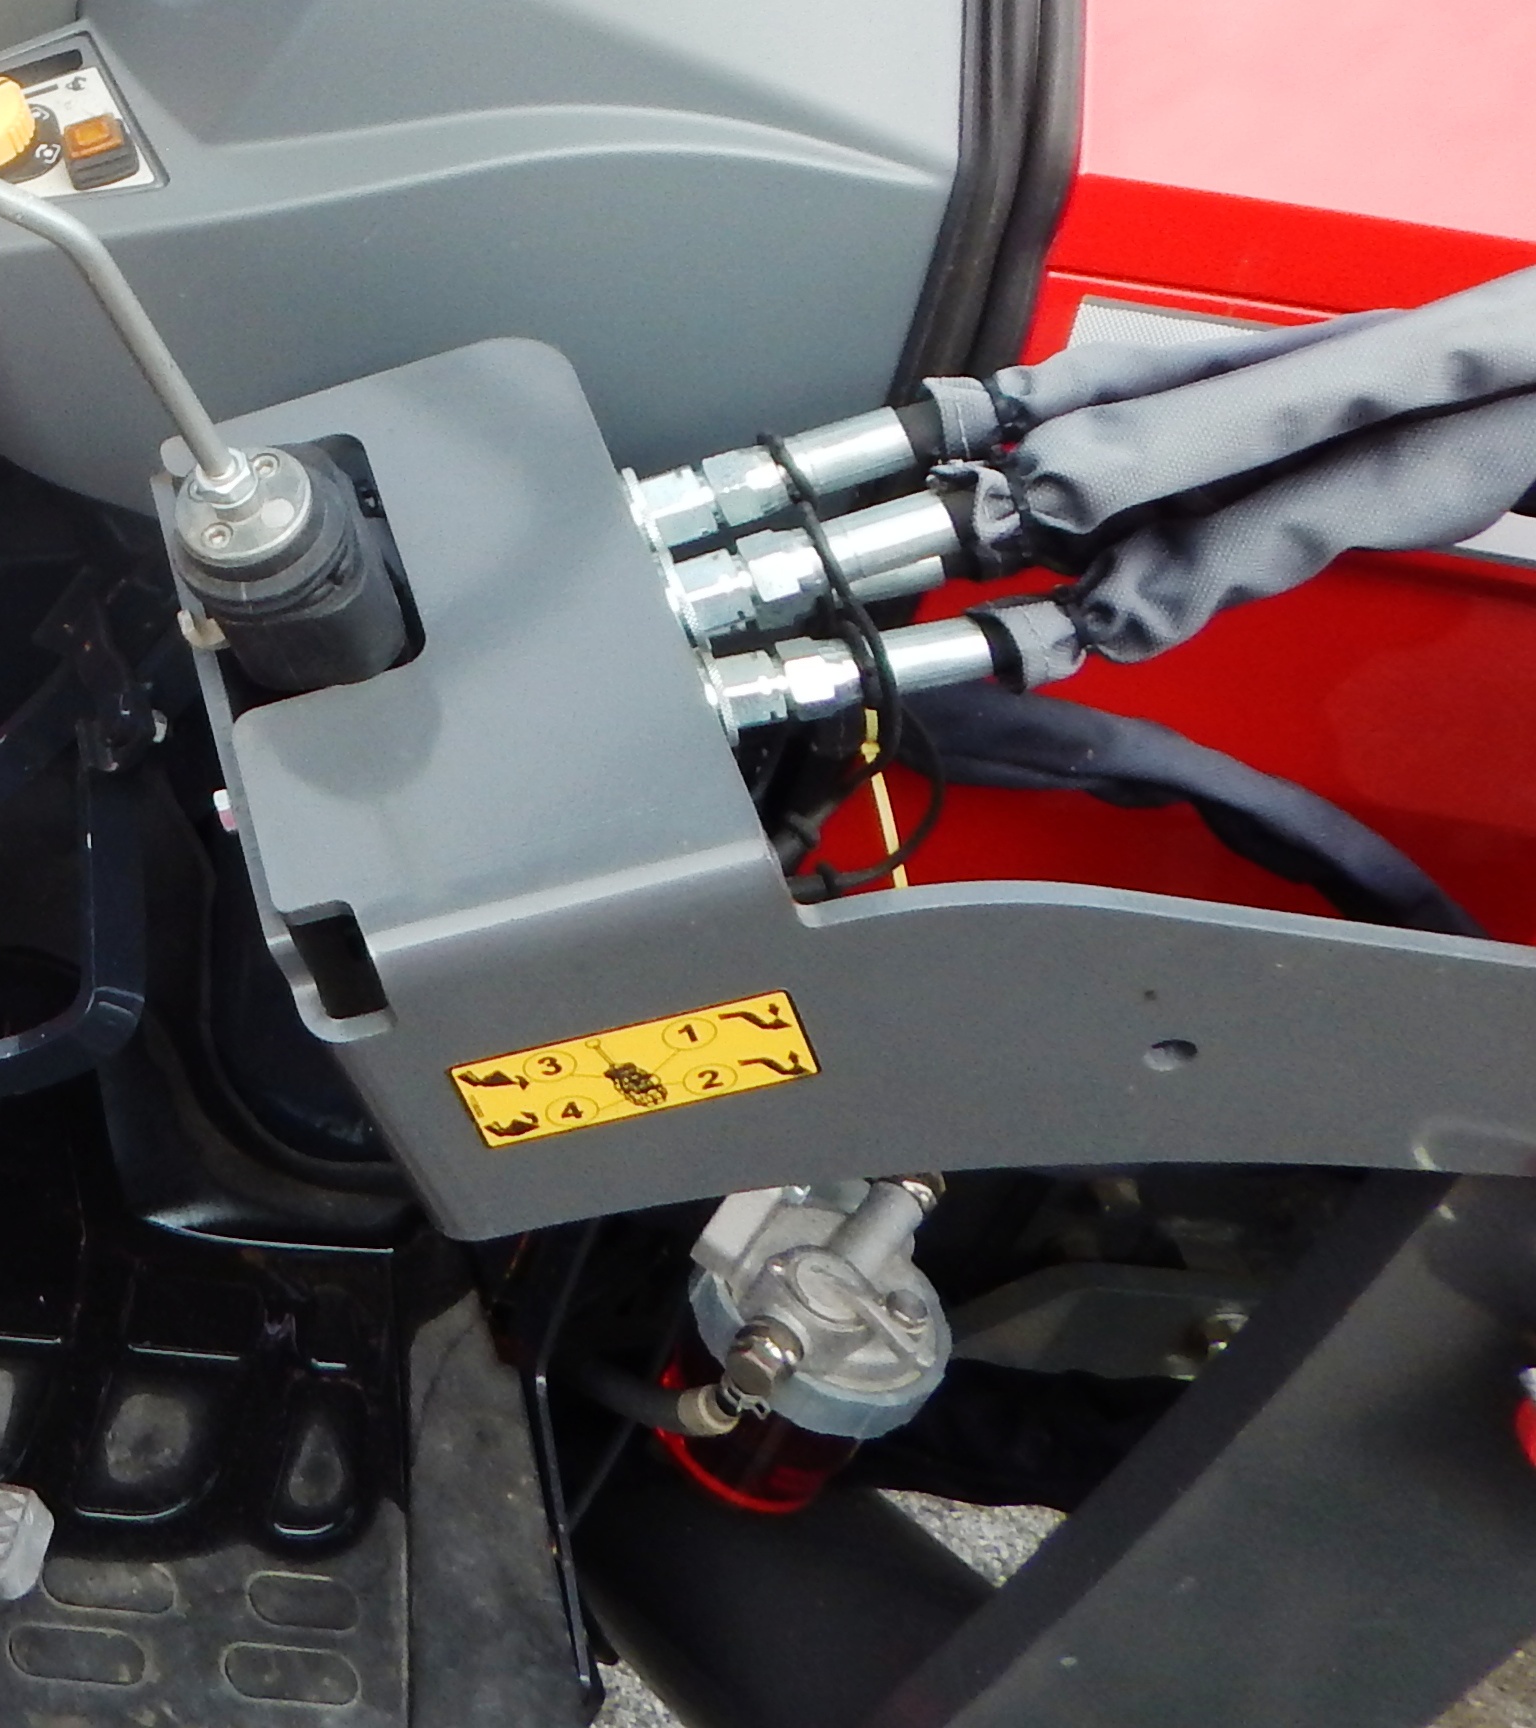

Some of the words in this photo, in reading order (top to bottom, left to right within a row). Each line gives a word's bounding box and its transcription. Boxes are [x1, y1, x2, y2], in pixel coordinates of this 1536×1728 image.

[677, 1023, 701, 1044] 1
[536, 1055, 564, 1076] 3
[696, 1069, 725, 1091] 2
[560, 1100, 584, 1120] 4
